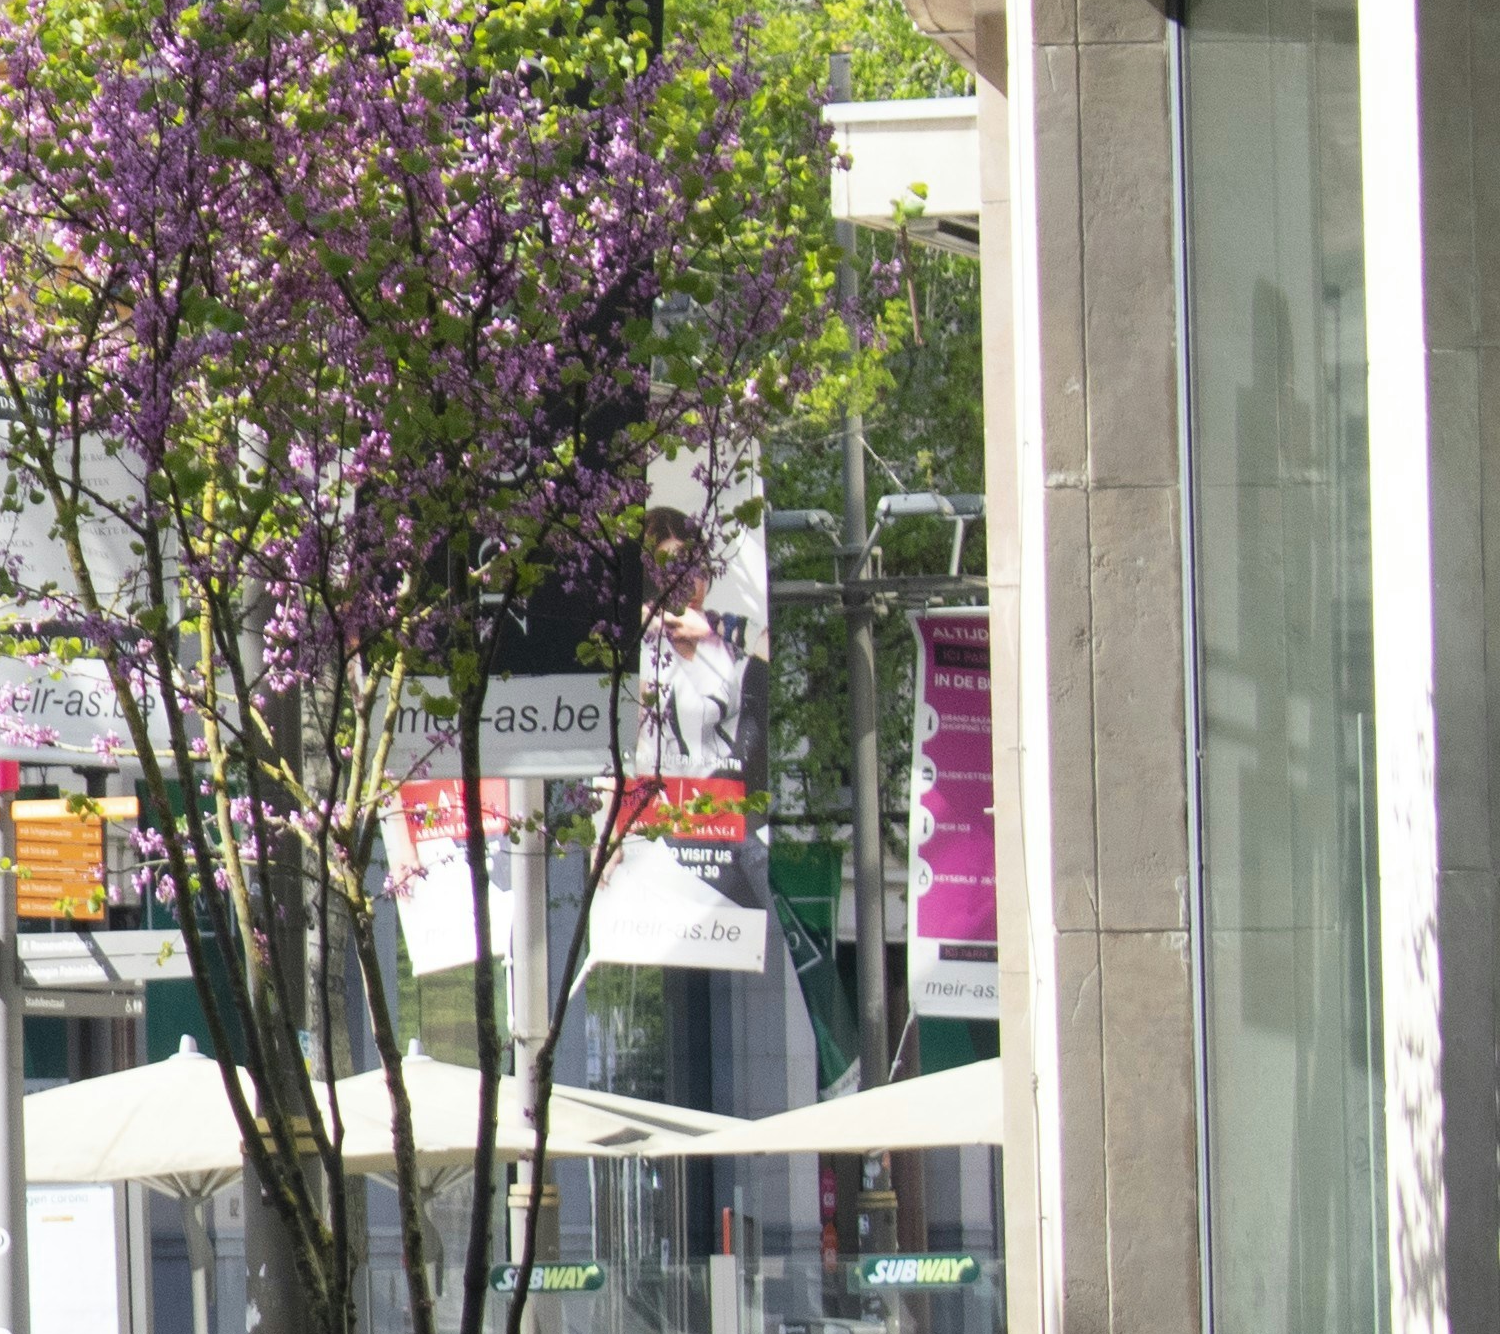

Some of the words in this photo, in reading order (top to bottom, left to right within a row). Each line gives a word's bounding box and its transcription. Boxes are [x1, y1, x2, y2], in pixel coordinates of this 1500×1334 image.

[932, 626, 990, 642] ALTIJD
[934, 673, 950, 688] IN
[953, 674, 975, 690] DE
[397, 695, 600, 734] me-as.be
[680, 847, 714, 863] VISIT
[714, 848, 733, 864] US
[867, 1256, 975, 1285] SUBWAY
